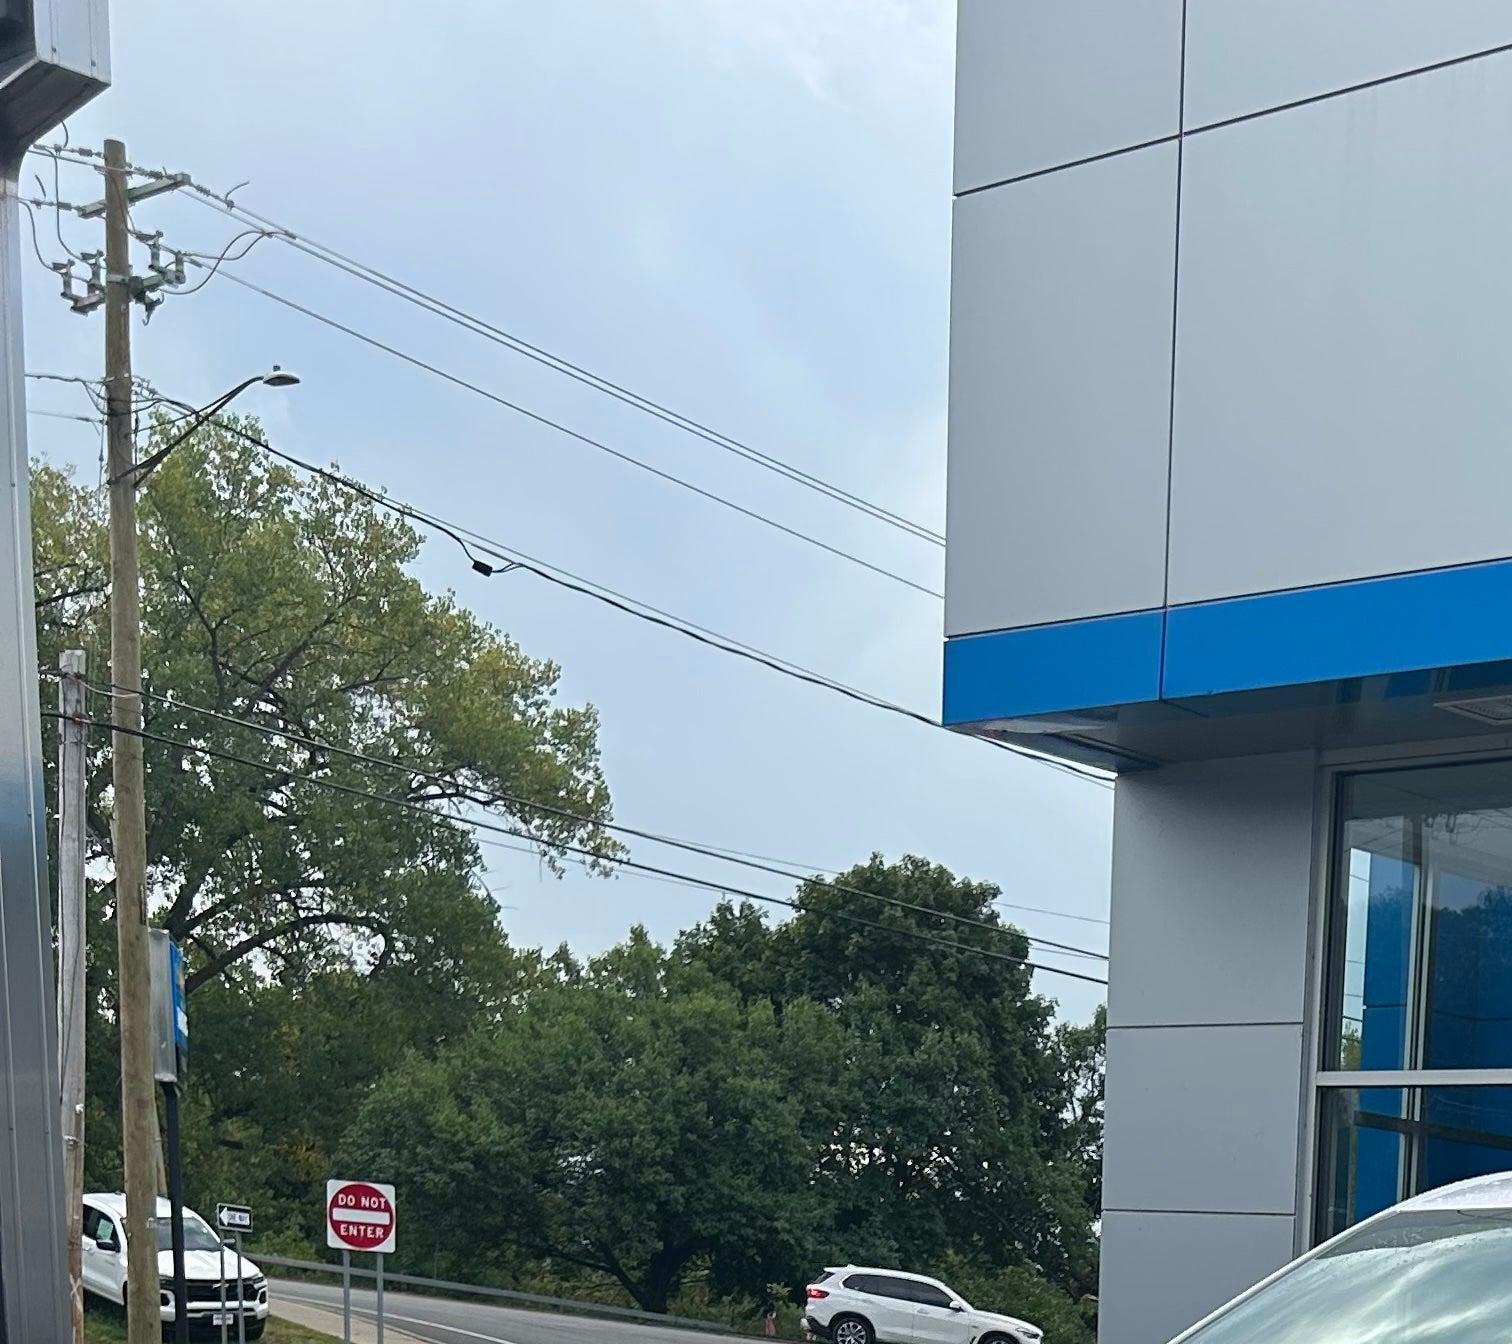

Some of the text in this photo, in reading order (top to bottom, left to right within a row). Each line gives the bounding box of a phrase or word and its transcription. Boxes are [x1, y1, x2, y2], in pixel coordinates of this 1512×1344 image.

[338, 1193, 387, 1209] DO NOT
[340, 1223, 384, 1239] ENTER
